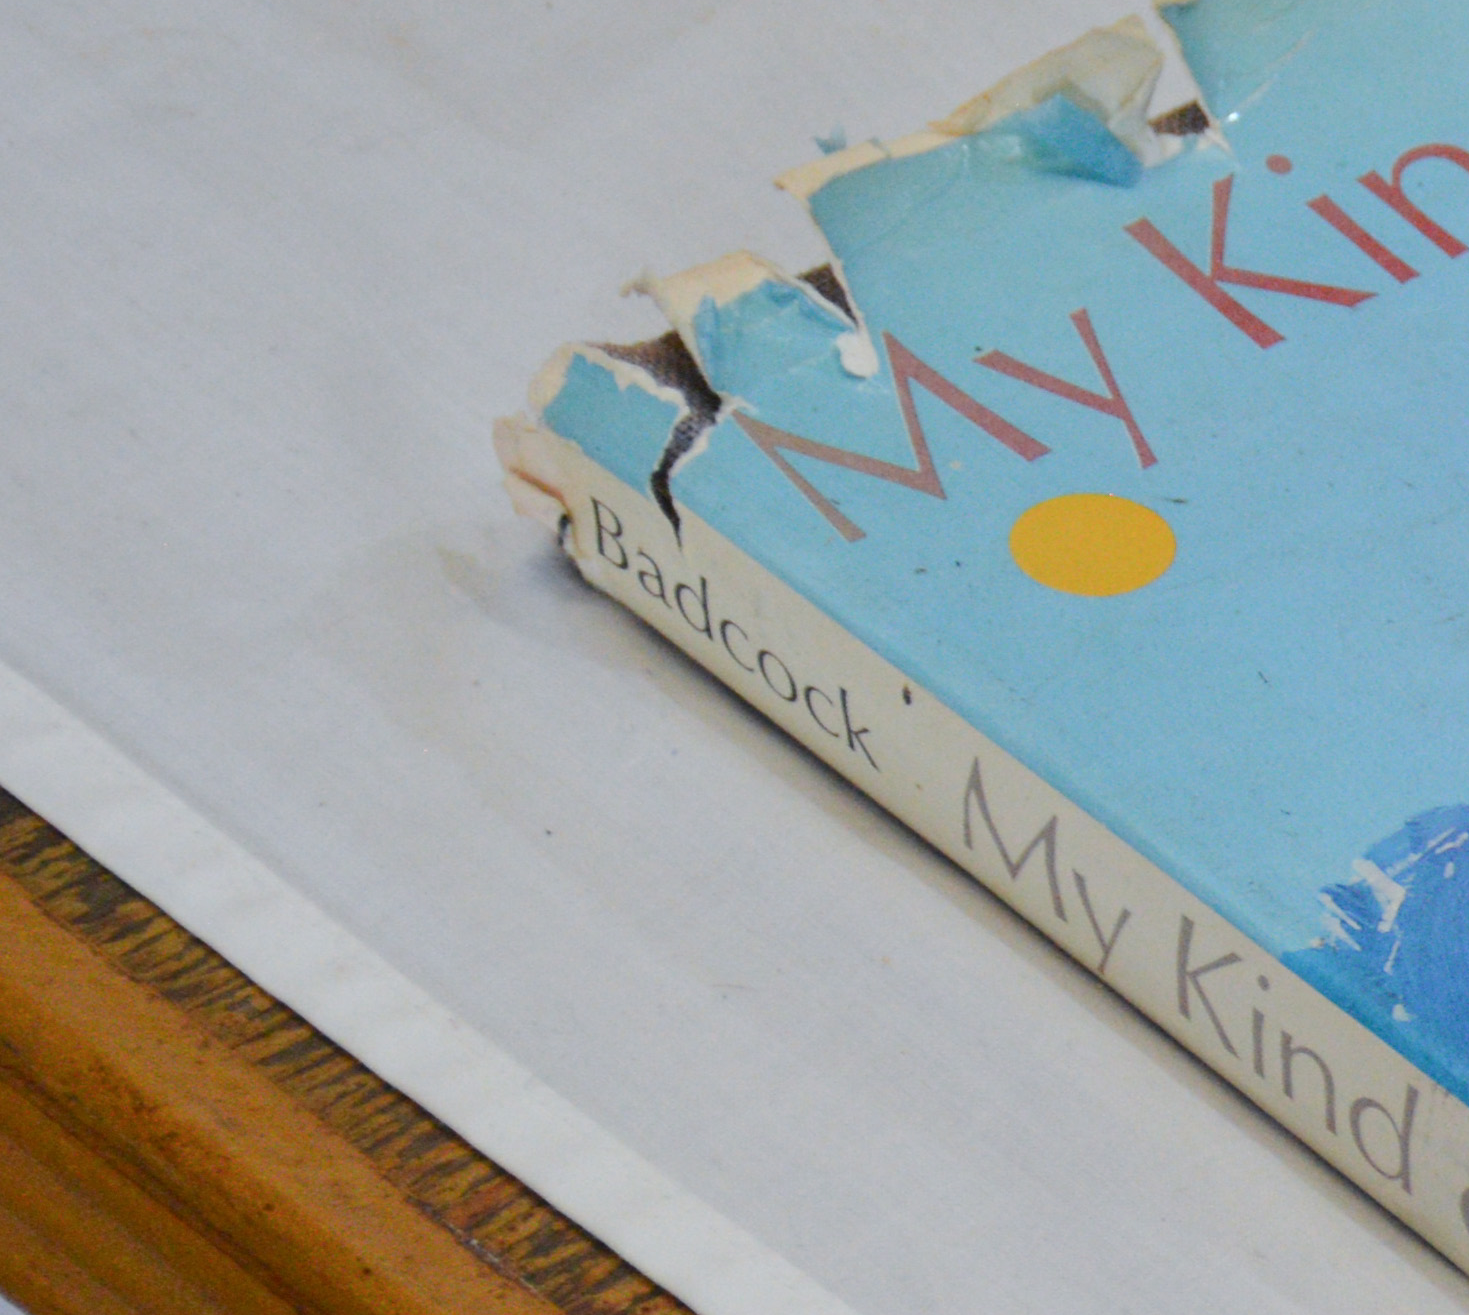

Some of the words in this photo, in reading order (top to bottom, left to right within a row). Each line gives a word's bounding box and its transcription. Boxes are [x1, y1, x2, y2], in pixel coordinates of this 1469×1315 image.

[729, 306, 1160, 545] My
[589, 495, 882, 771] Badcock
[961, 754, 1134, 978] My
[1176, 913, 1420, 1196] Kind
